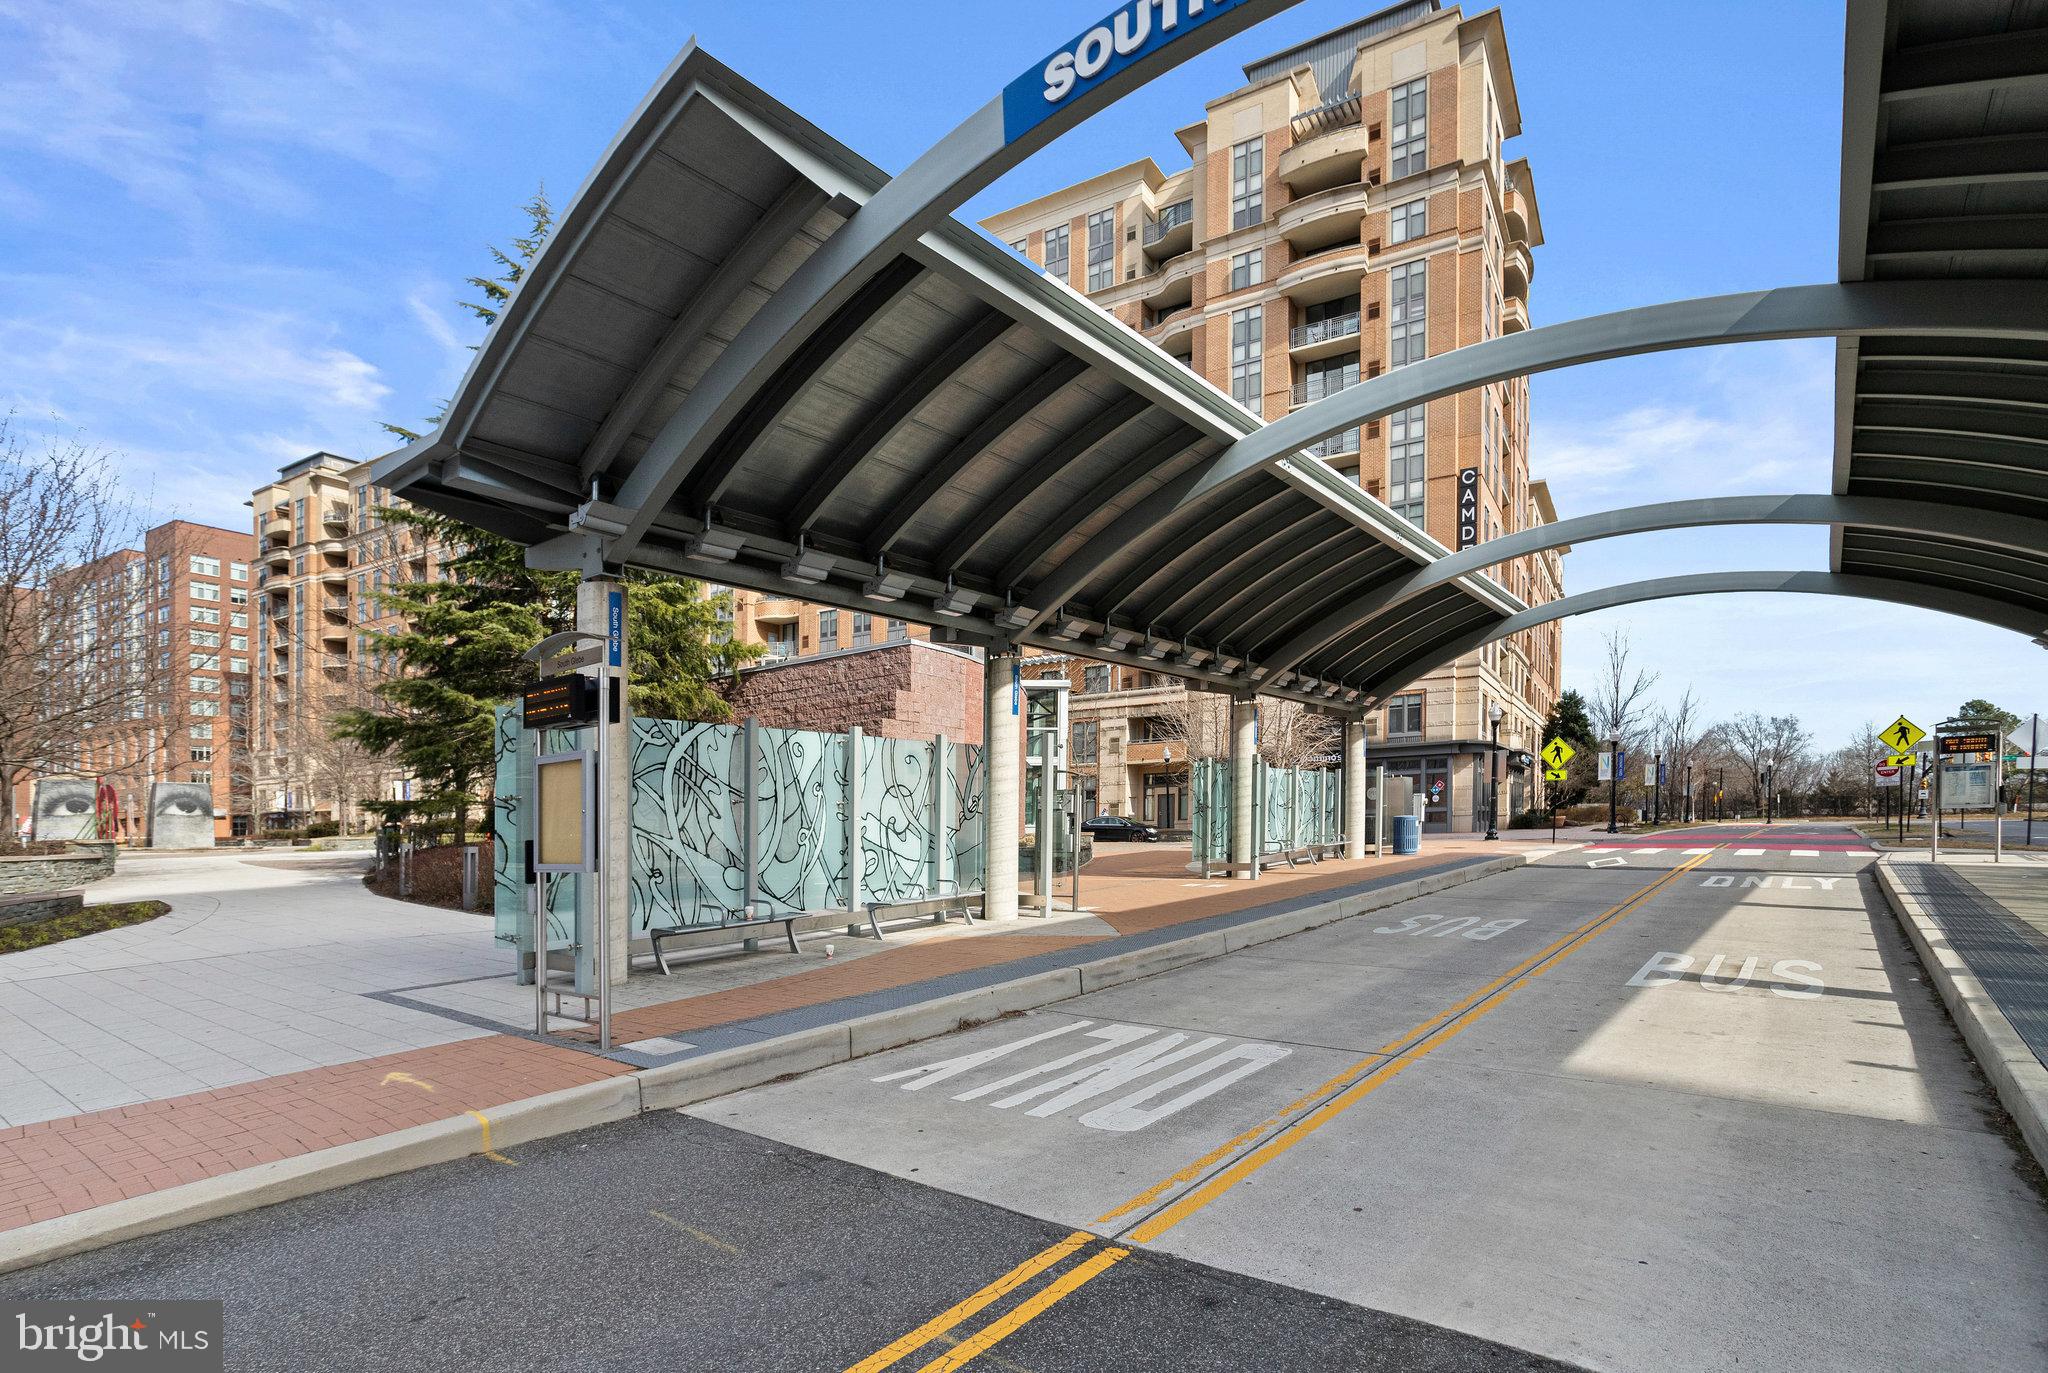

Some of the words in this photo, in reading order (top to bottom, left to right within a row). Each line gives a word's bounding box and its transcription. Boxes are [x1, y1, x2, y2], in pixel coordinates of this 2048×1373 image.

[1043, 0, 1225, 103] SOUT
[557, 660, 570, 669] South
[571, 656, 585, 666] Glebe
[1699, 874, 1843, 890] ONLY
[1373, 913, 1529, 941] BUS
[1625, 951, 1825, 1000] BUS
[870, 1020, 1294, 1132] ONLY
